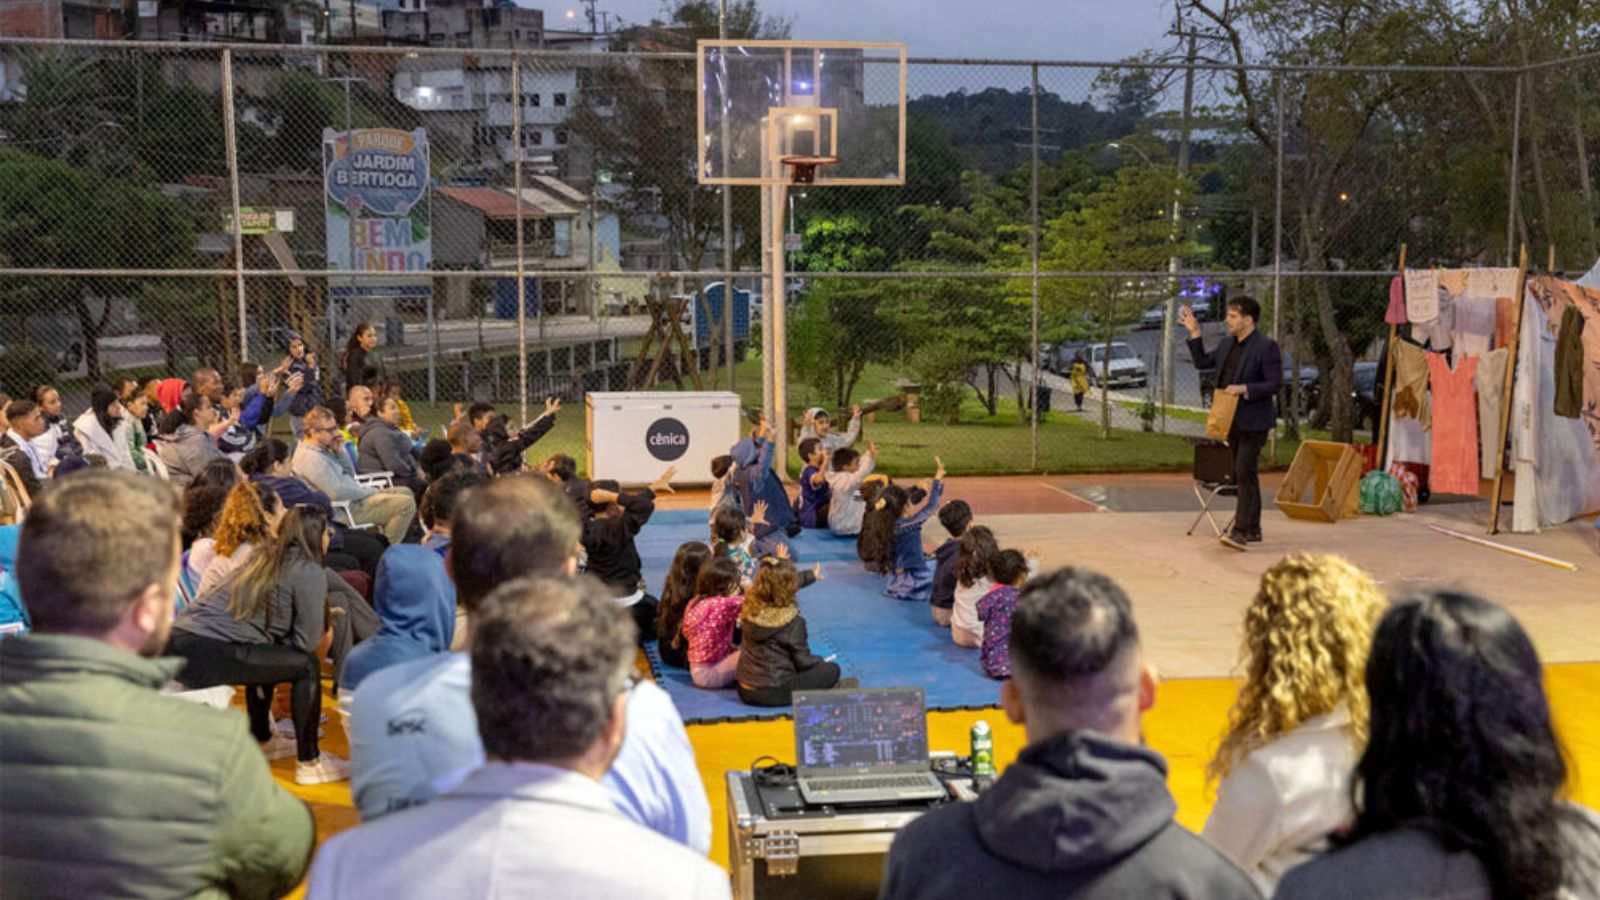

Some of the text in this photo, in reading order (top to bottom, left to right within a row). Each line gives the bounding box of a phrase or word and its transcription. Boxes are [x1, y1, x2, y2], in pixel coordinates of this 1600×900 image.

[353, 154, 416, 171] JARDIM
[336, 171, 418, 187] BERTIOGA
[649, 432, 686, 446] cênica
